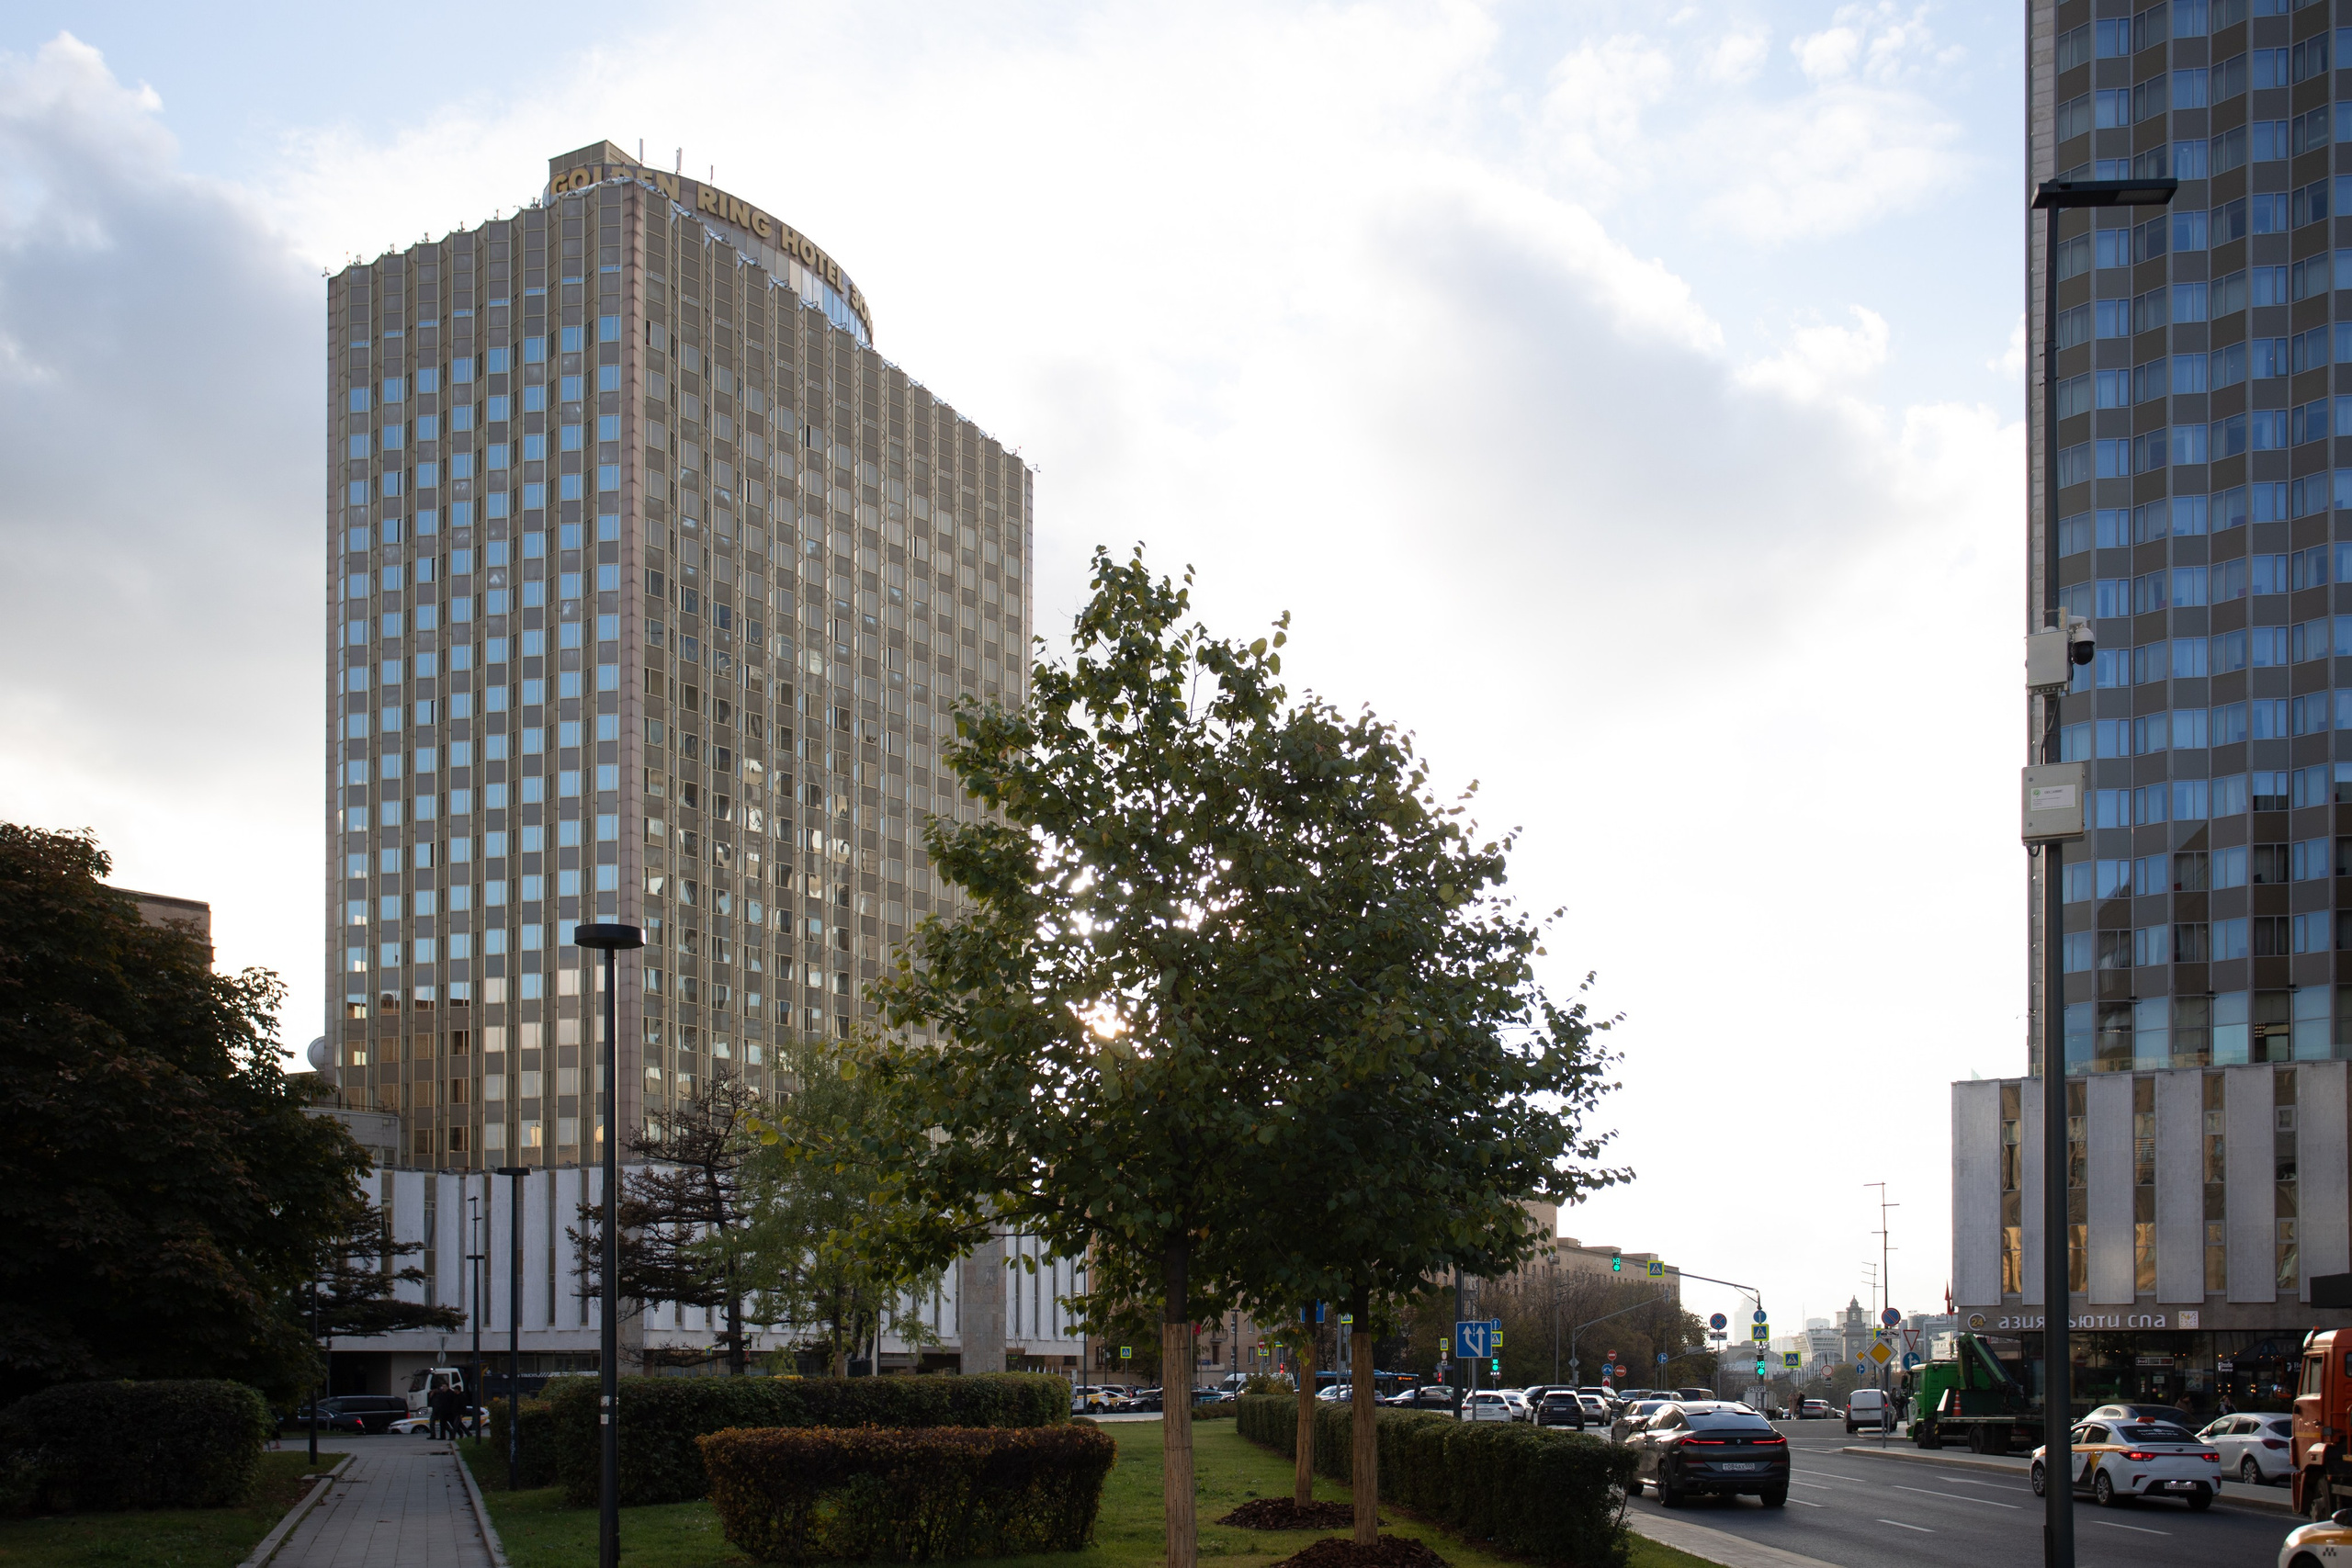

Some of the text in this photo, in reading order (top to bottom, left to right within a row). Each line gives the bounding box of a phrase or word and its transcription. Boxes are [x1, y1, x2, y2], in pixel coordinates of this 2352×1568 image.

[697, 184, 772, 239] RING
[781, 224, 844, 295] HOTEL
[1971, 1317, 1984, 1326] 24
[1998, 1314, 2166, 1329] азия ьюти спа
